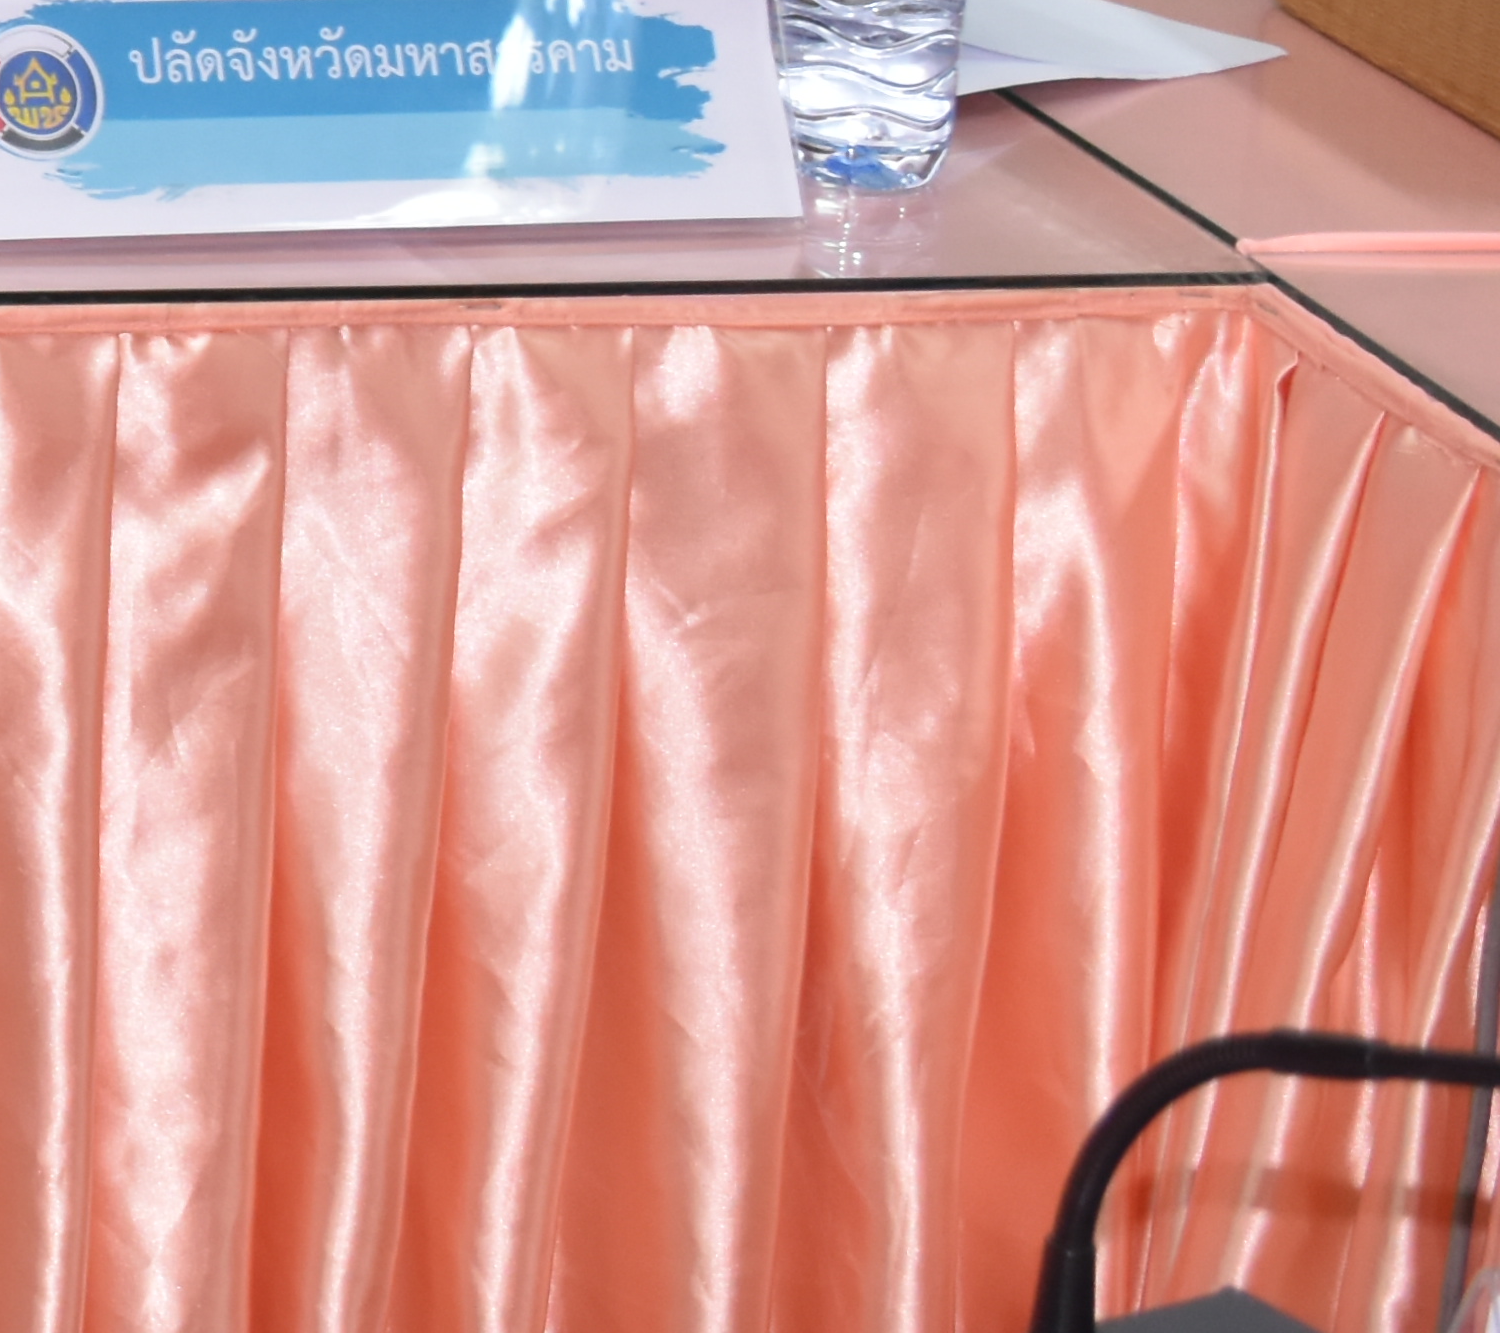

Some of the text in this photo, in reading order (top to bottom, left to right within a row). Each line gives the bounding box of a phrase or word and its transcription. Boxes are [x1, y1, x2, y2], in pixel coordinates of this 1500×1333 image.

[128, 25, 635, 84] ปลัดจังหวัดมหาสรคาม
